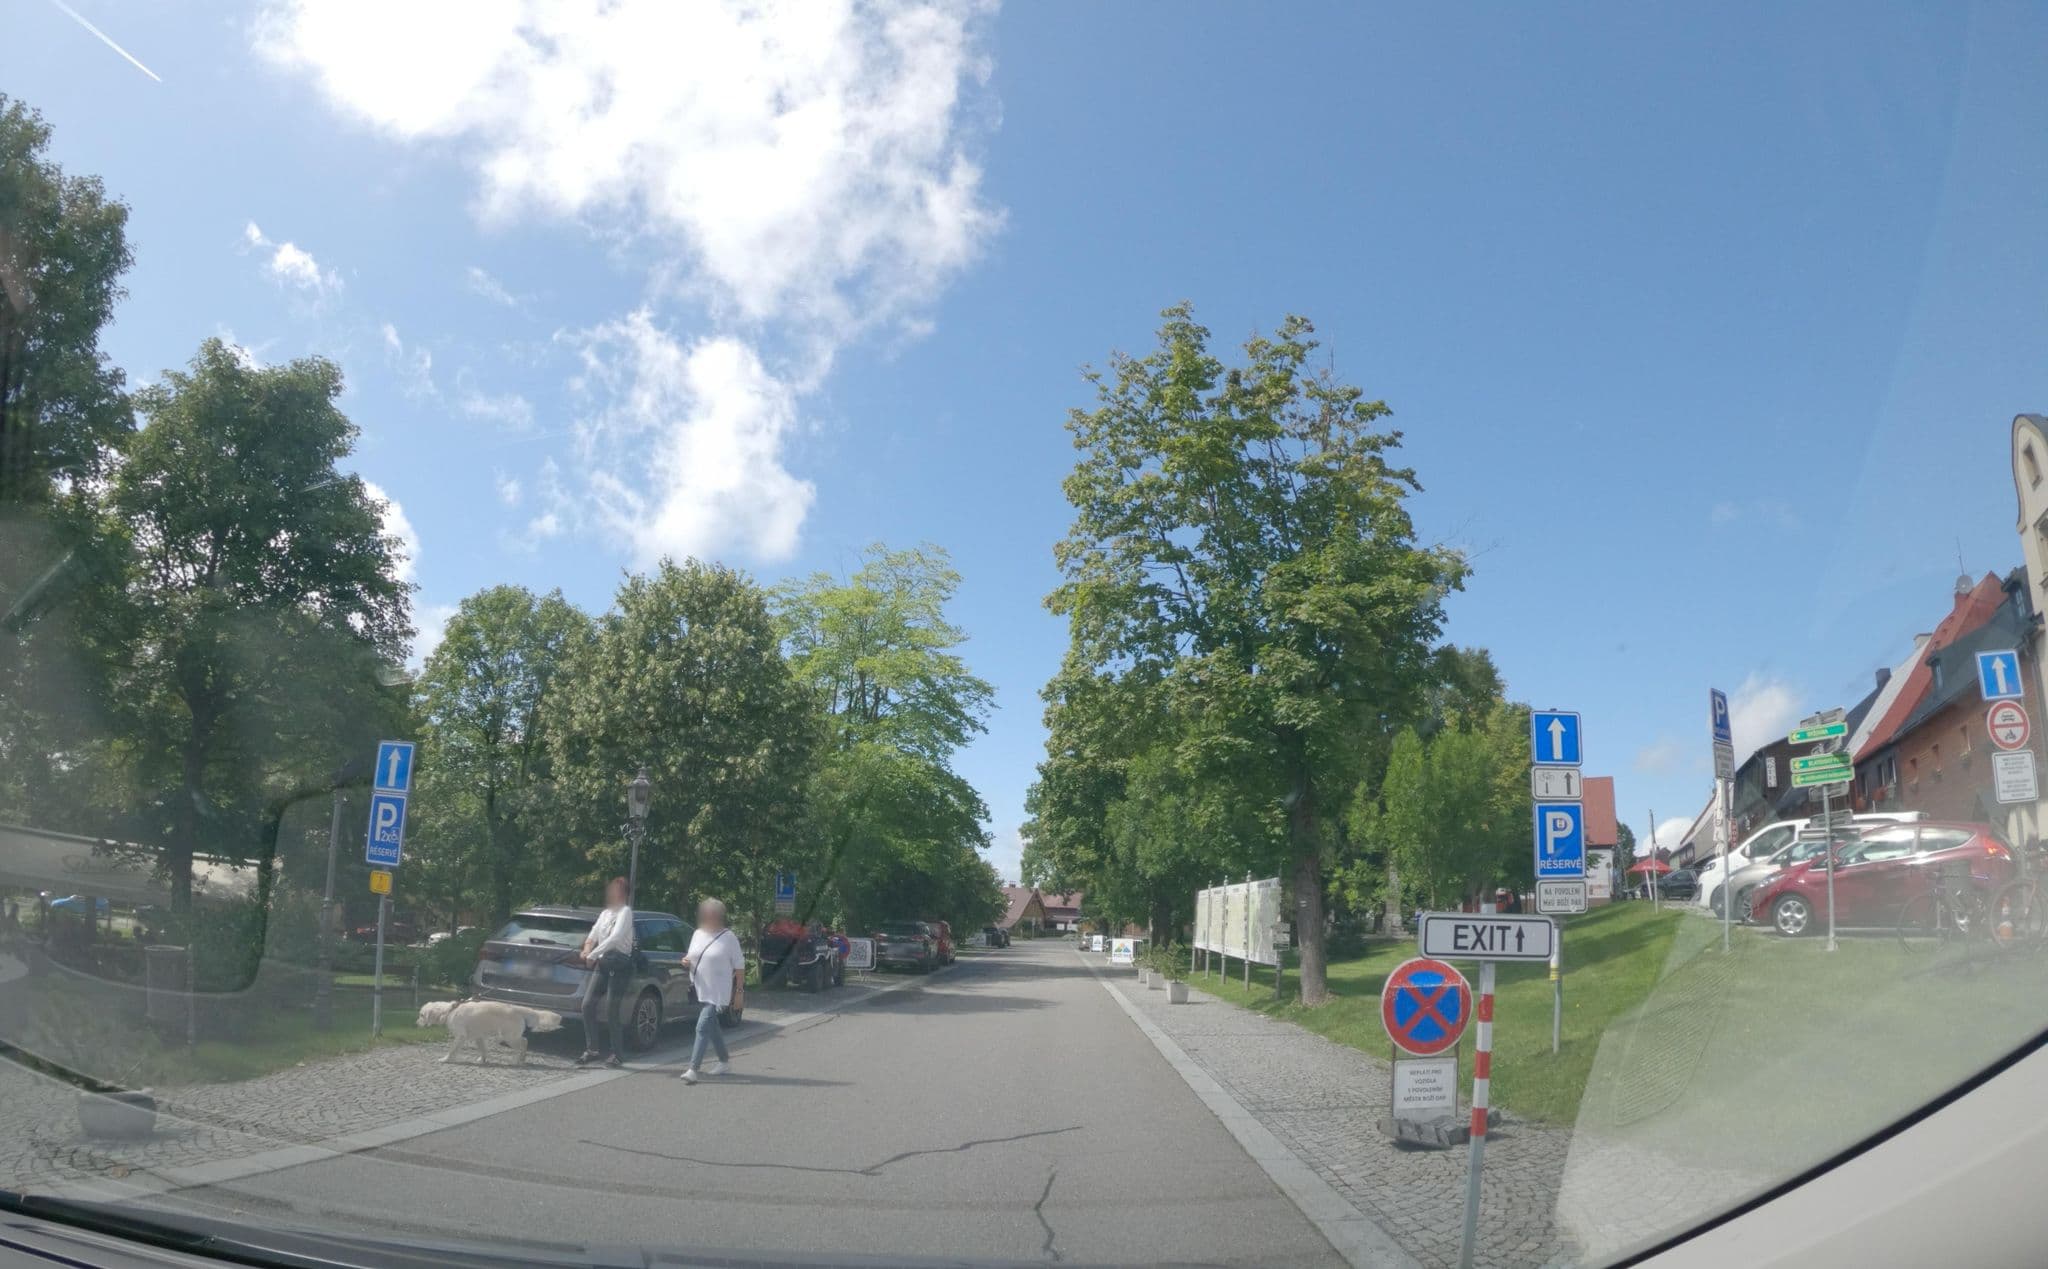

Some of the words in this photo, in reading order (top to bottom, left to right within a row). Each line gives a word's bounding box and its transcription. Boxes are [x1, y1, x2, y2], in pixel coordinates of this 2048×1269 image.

[375, 802, 398, 841] P
[1545, 811, 1574, 854] P
[1540, 857, 1583, 869] RÉSERVÉ
[1453, 924, 1512, 952] EXIT
